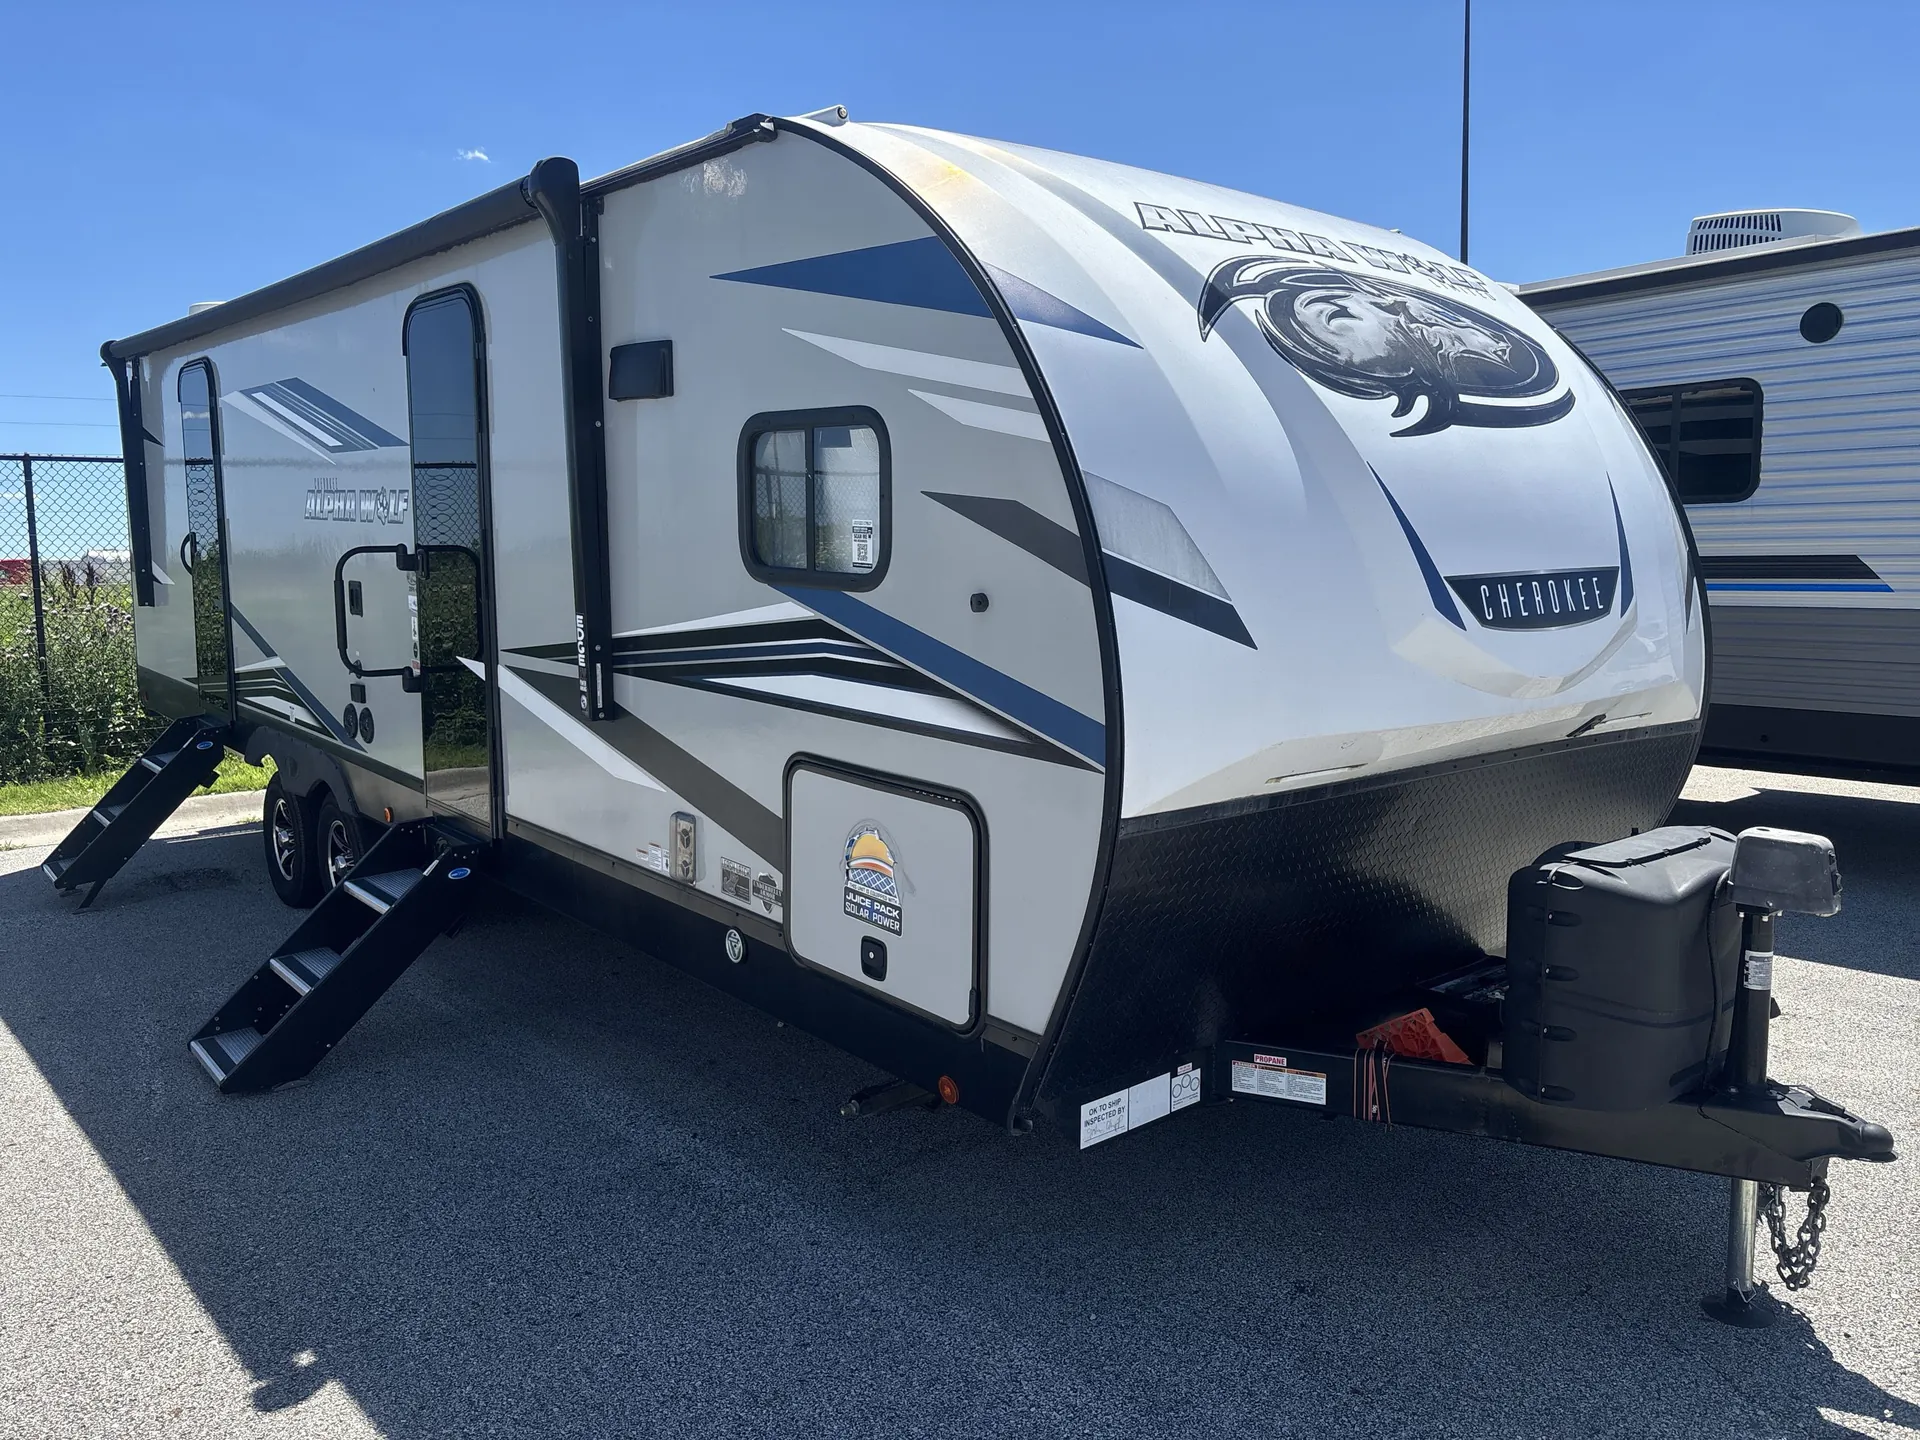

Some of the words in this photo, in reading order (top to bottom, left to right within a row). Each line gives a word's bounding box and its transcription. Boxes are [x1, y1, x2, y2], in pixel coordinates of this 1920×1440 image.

[1133, 200, 1358, 264] ALPHA
[304, 489, 357, 522] ALPHA
[1480, 577, 1604, 620] CHEROKEE
[576, 614, 586, 668] EDGE
[845, 892, 872, 908] JUICE
[874, 901, 900, 920] PACK
[845, 902, 870, 919] SOLAR
[873, 912, 900, 932] POWER
[1255, 1055, 1286, 1066] PROPANE
[1084, 1109, 1117, 1128] INSPECTED
[1117, 1106, 1126, 1116] BY
[1088, 1106, 1098, 1116] OK
[1099, 1103, 1107, 1112] TO
[1108, 1097, 1122, 1109] SHIP
